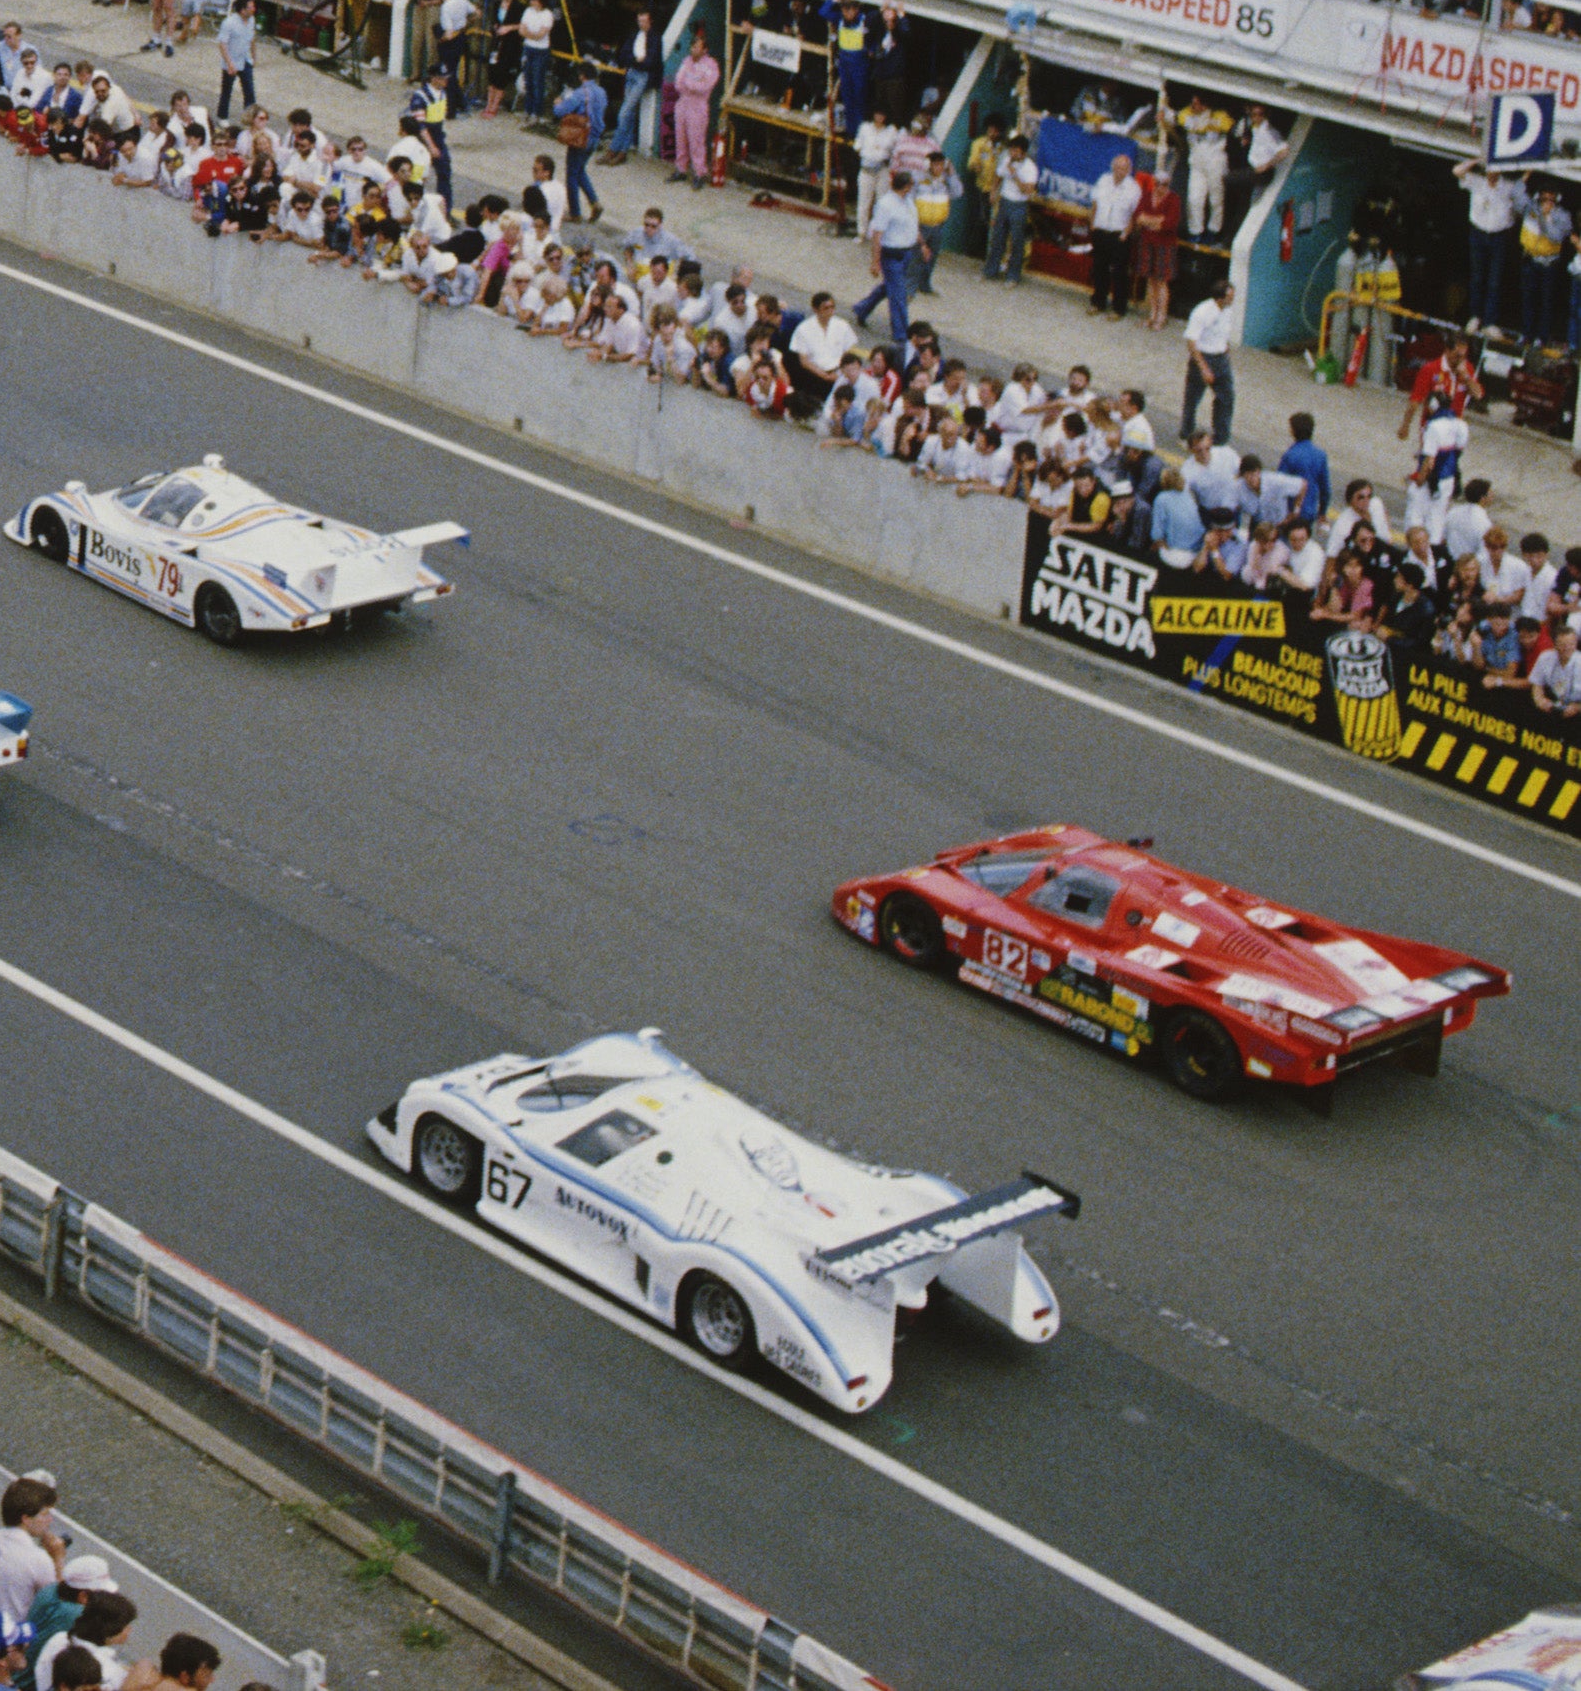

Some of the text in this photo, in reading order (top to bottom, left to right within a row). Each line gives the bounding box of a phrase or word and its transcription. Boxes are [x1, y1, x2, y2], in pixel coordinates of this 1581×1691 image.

[1235, 4, 1274, 38] 85
[1380, 32, 1580, 109] MAZDASPEED
[1494, 94, 1543, 159] D
[88, 527, 181, 599] Bovis 79
[1040, 535, 1158, 616] SAFT
[1031, 579, 1157, 660] MAZDA
[1156, 601, 1280, 633] ALCALINE
[1182, 655, 1318, 724] PLUS LONGTEMPS
[1232, 652, 1322, 699] BEAUCOUP
[1279, 643, 1324, 679] DURE
[1409, 663, 1470, 703] LA PILE
[1405, 690, 1444, 717] AUX
[1443, 701, 1517, 746] RAYURES
[1521, 728, 1562, 762] NOIR
[985, 930, 1028, 975] 82
[486, 1159, 533, 1210] 67
[556, 1185, 630, 1243] AUTOVOX
